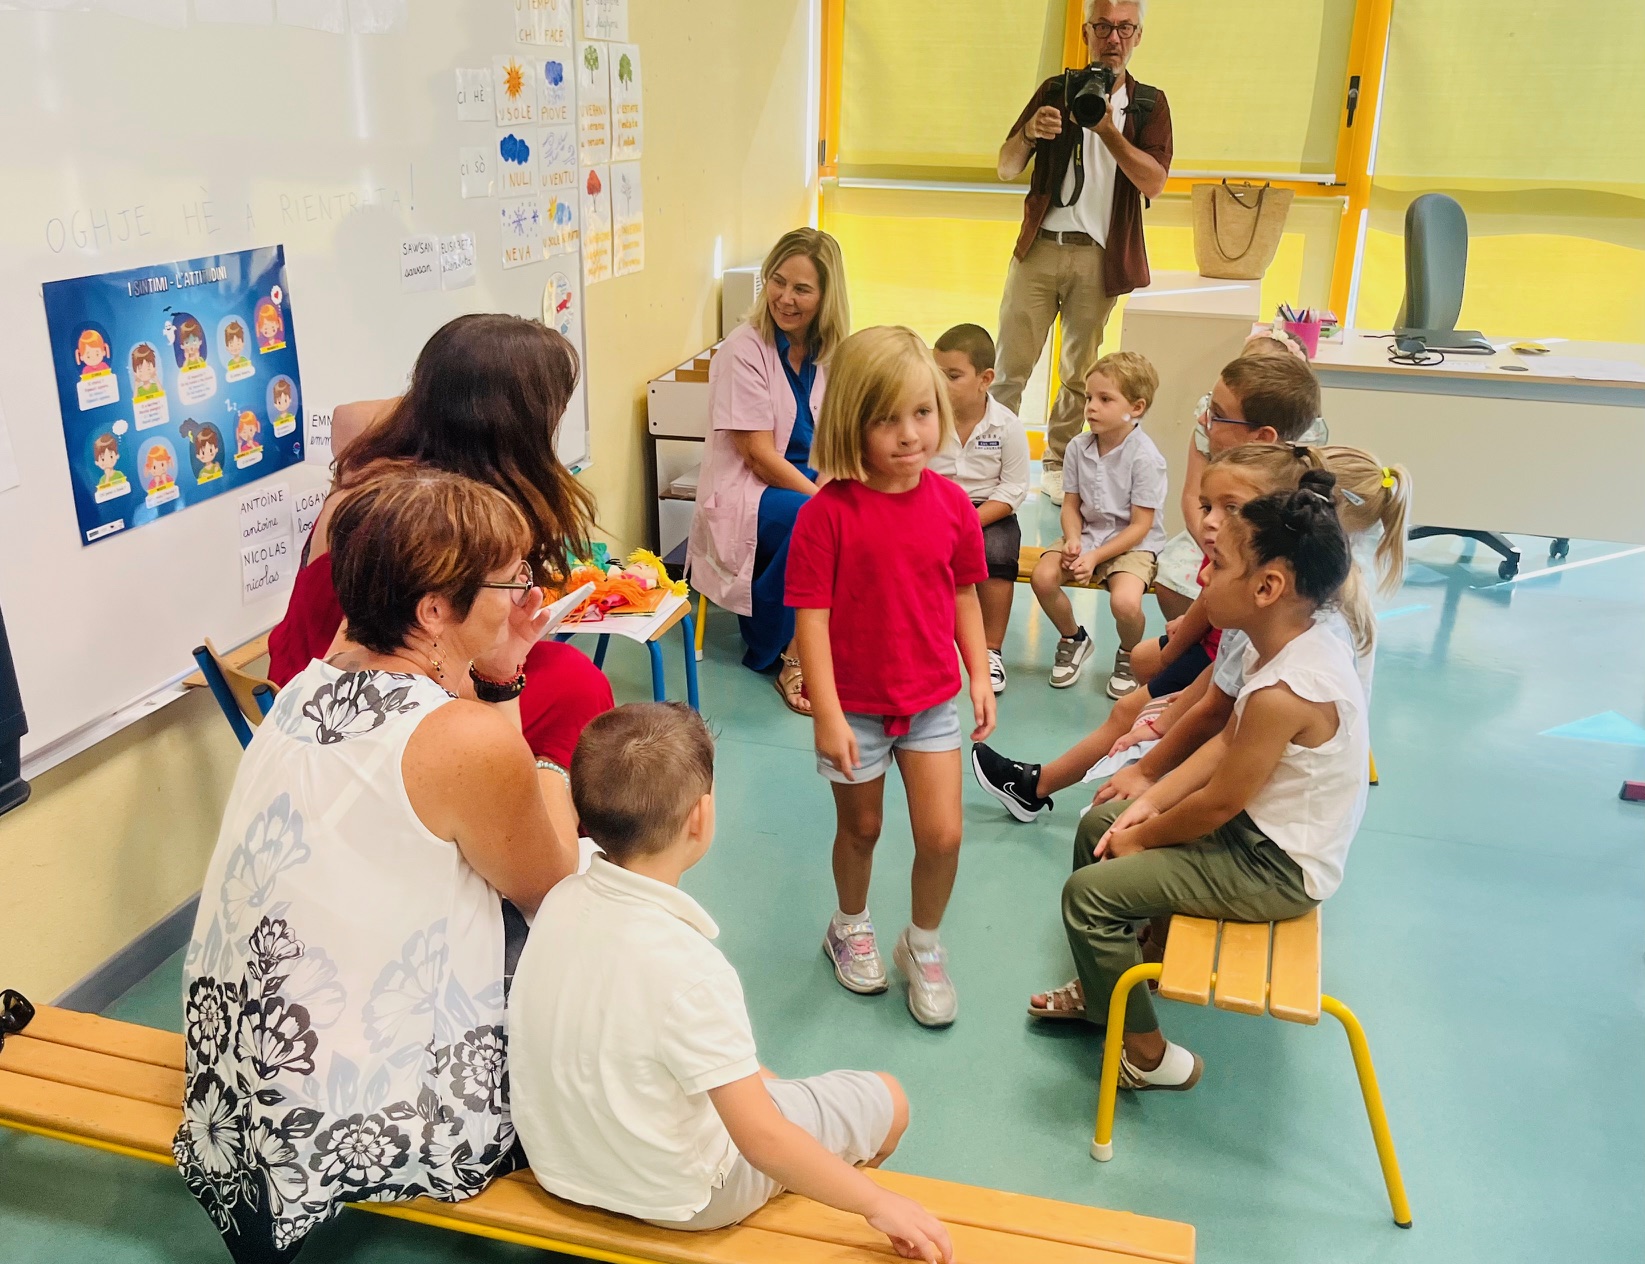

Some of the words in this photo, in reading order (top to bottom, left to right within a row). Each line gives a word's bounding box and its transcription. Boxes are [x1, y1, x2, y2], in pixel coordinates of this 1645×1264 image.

[544, 28, 564, 43] FACE
[506, 105, 532, 121] SOLE
[541, 105, 568, 121] PIOVE
[509, 169, 532, 188] NULI
[549, 170, 575, 187] VENTU
[46, 205, 150, 254] OGHJE
[182, 186, 221, 236] HÈ
[402, 241, 434, 256] SAWSAN
[505, 244, 532, 263] NEVA
[127, 280, 133, 297] I
[134, 276, 169, 297] SINTIMI
[175, 265, 228, 290] L'ATTITUDINI
[242, 517, 279, 538] antoine
[243, 541, 288, 567] NICOLAS
[244, 564, 280, 593] nicolas
